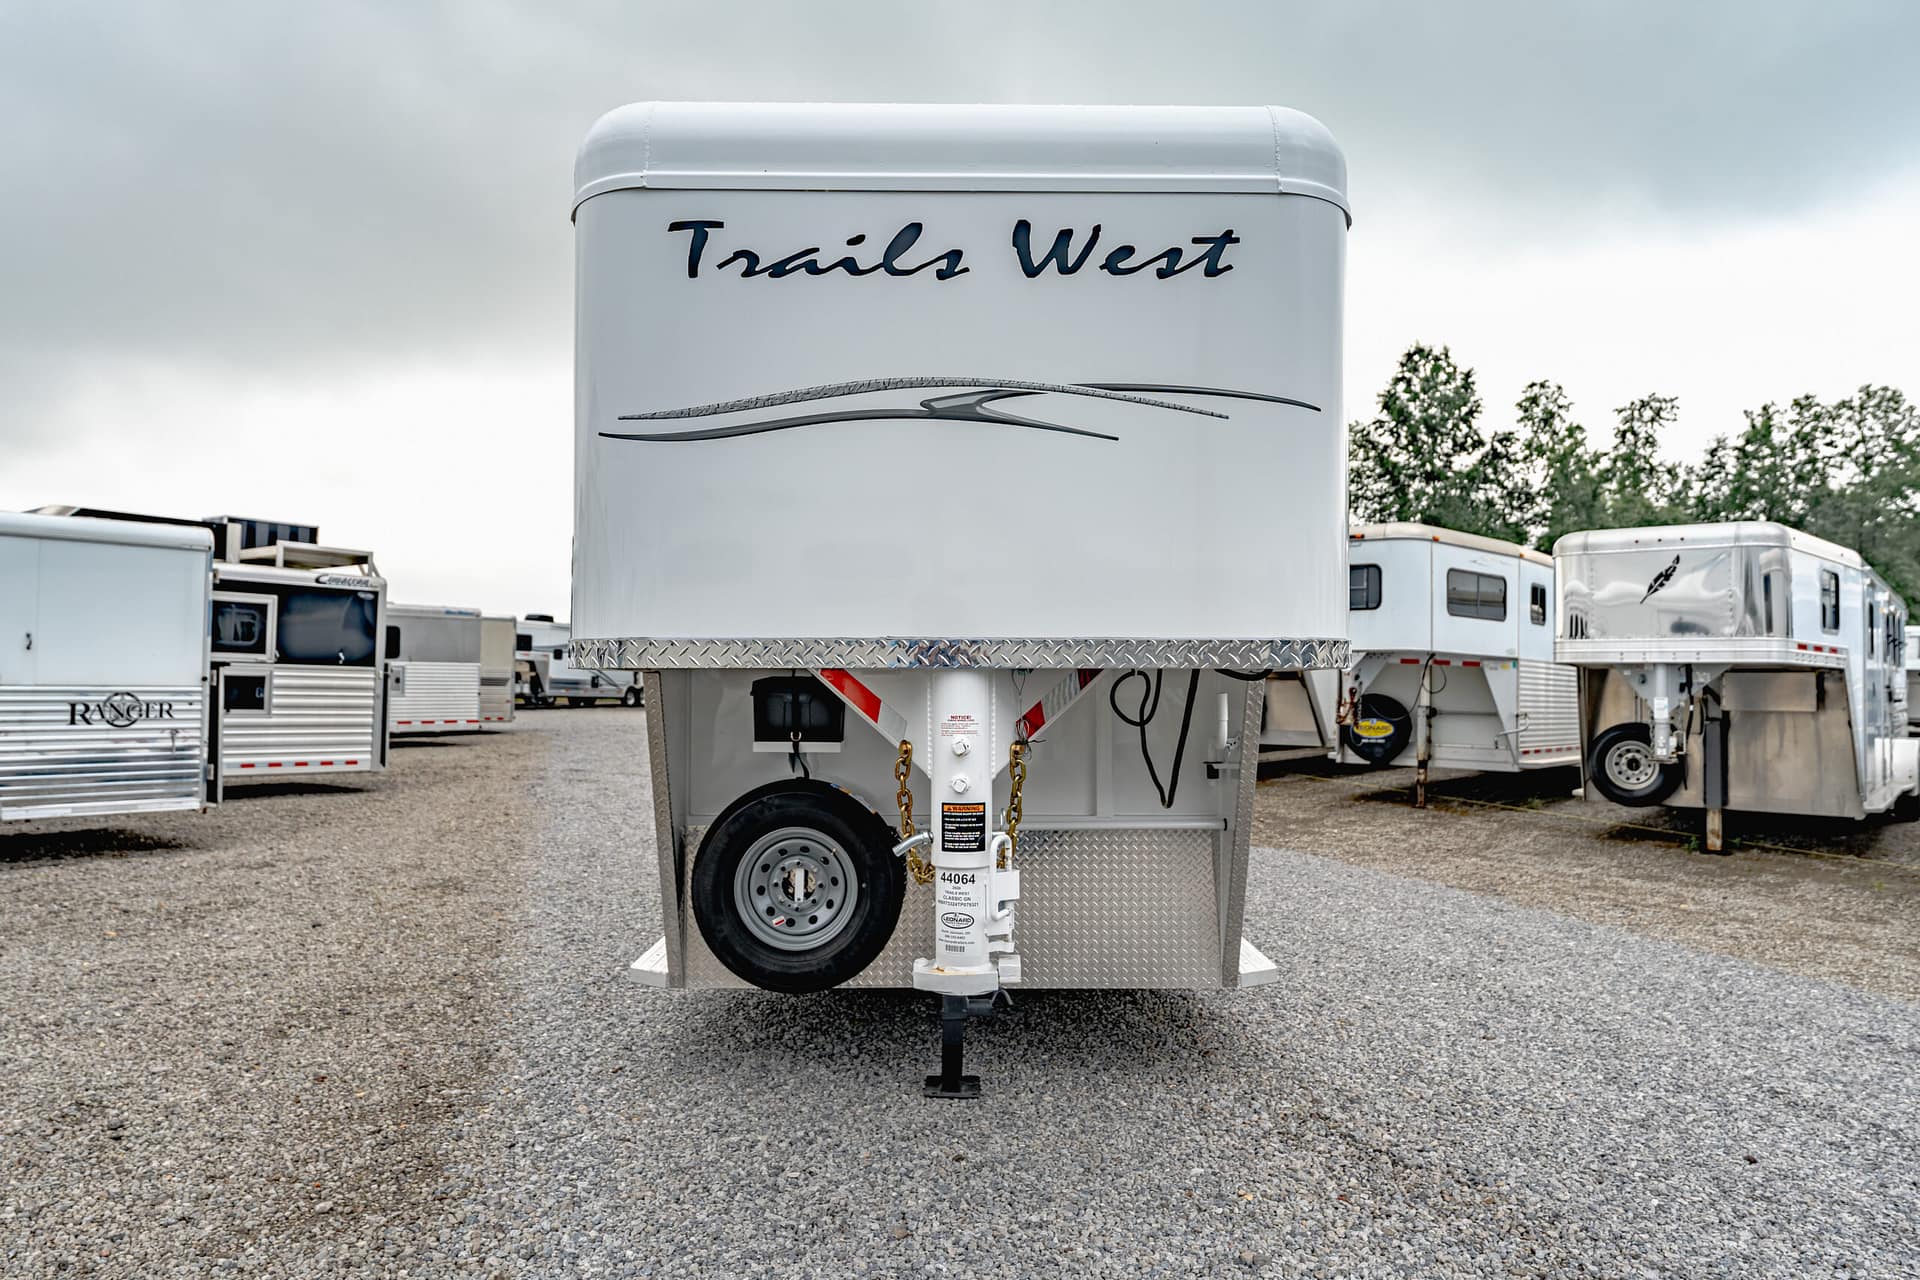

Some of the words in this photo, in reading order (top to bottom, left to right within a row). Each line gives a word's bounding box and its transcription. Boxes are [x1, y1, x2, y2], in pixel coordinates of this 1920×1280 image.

[667, 220, 970, 281] Trails
[1012, 219, 1240, 279] West
[67, 702, 174, 725] RANGER
[940, 872, 976, 884] 44064
